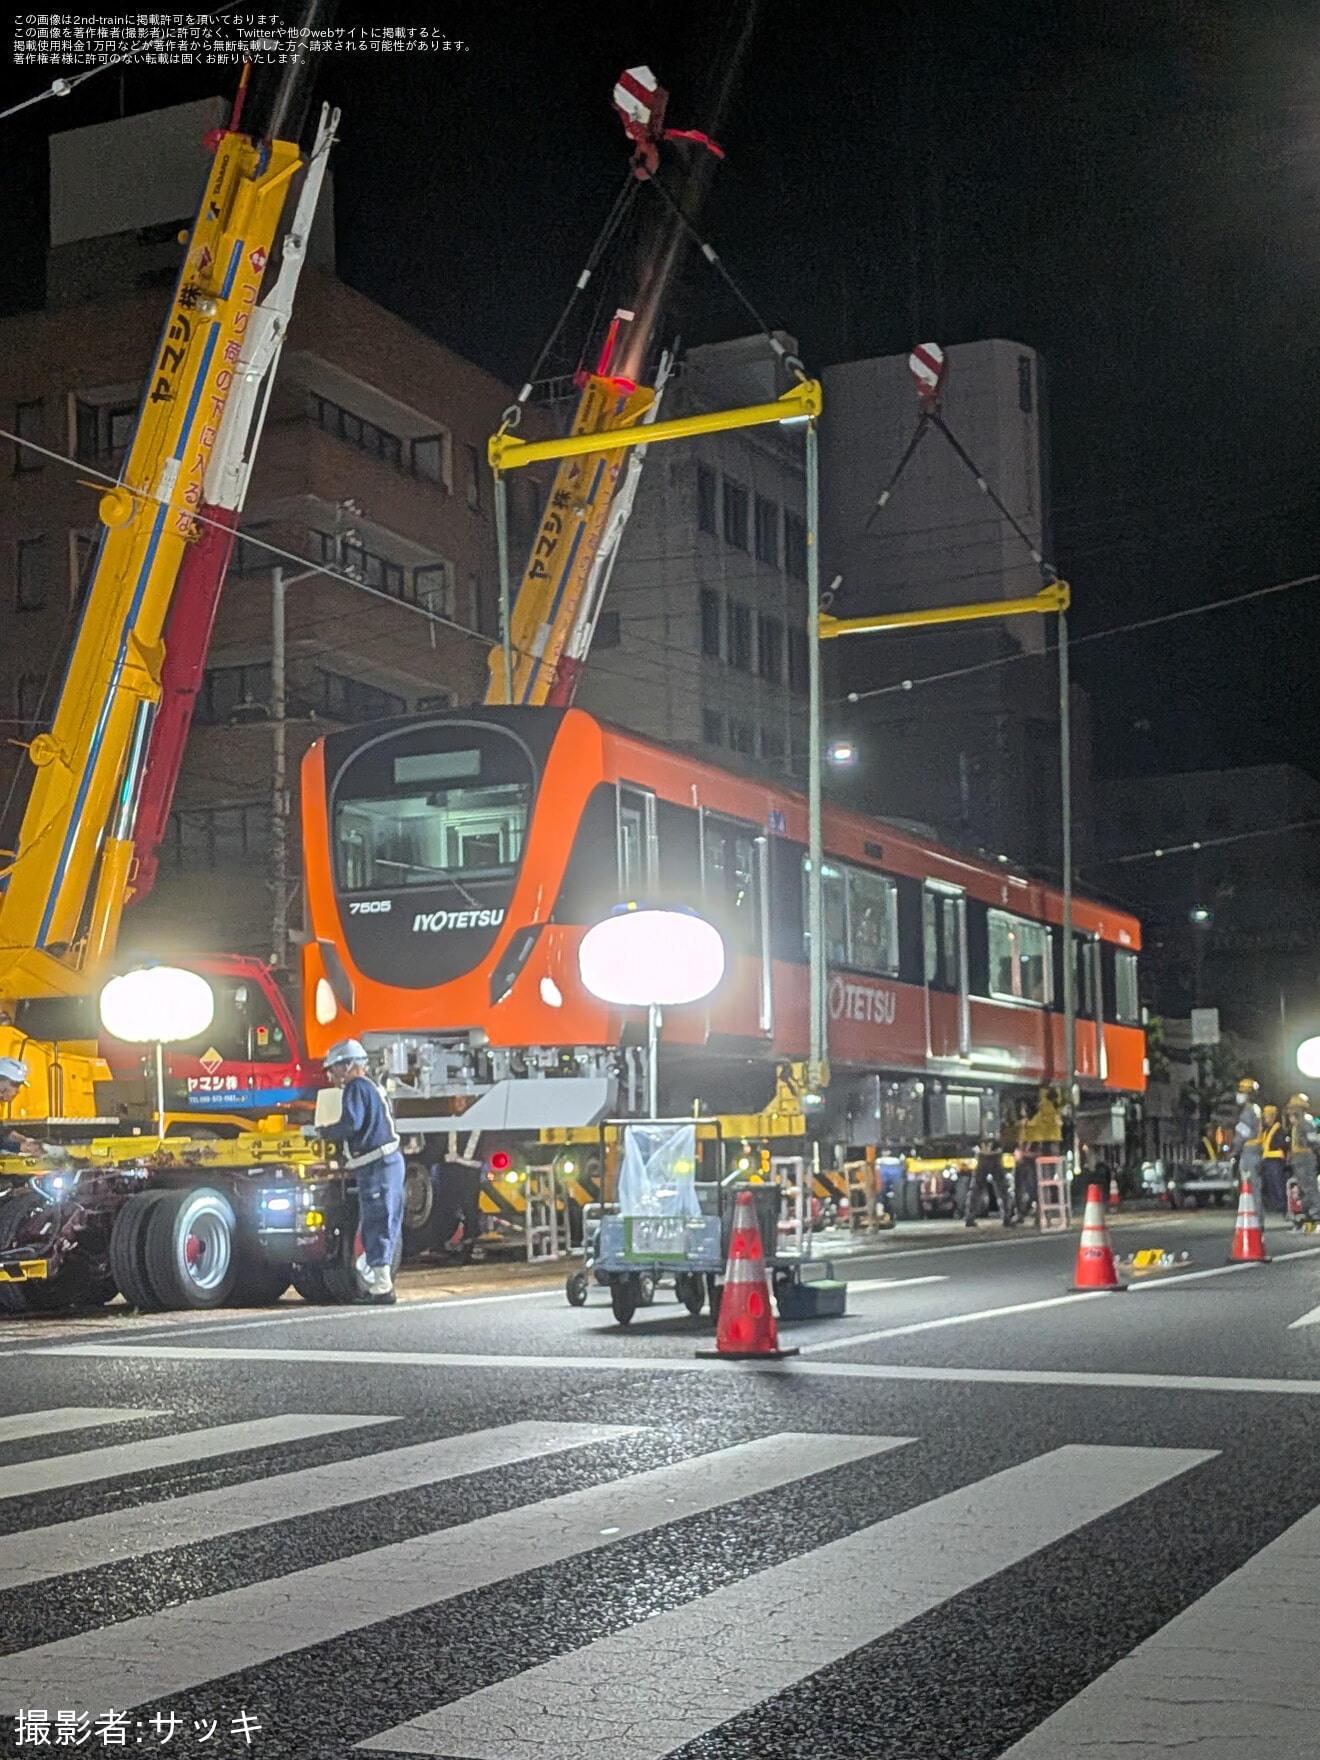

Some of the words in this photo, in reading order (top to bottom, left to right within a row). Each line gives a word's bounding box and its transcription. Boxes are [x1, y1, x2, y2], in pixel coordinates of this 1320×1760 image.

[349, 900, 391, 914] 7505
[413, 909, 504, 932] IYOTETSU
[826, 976, 896, 1025] OTETSU
